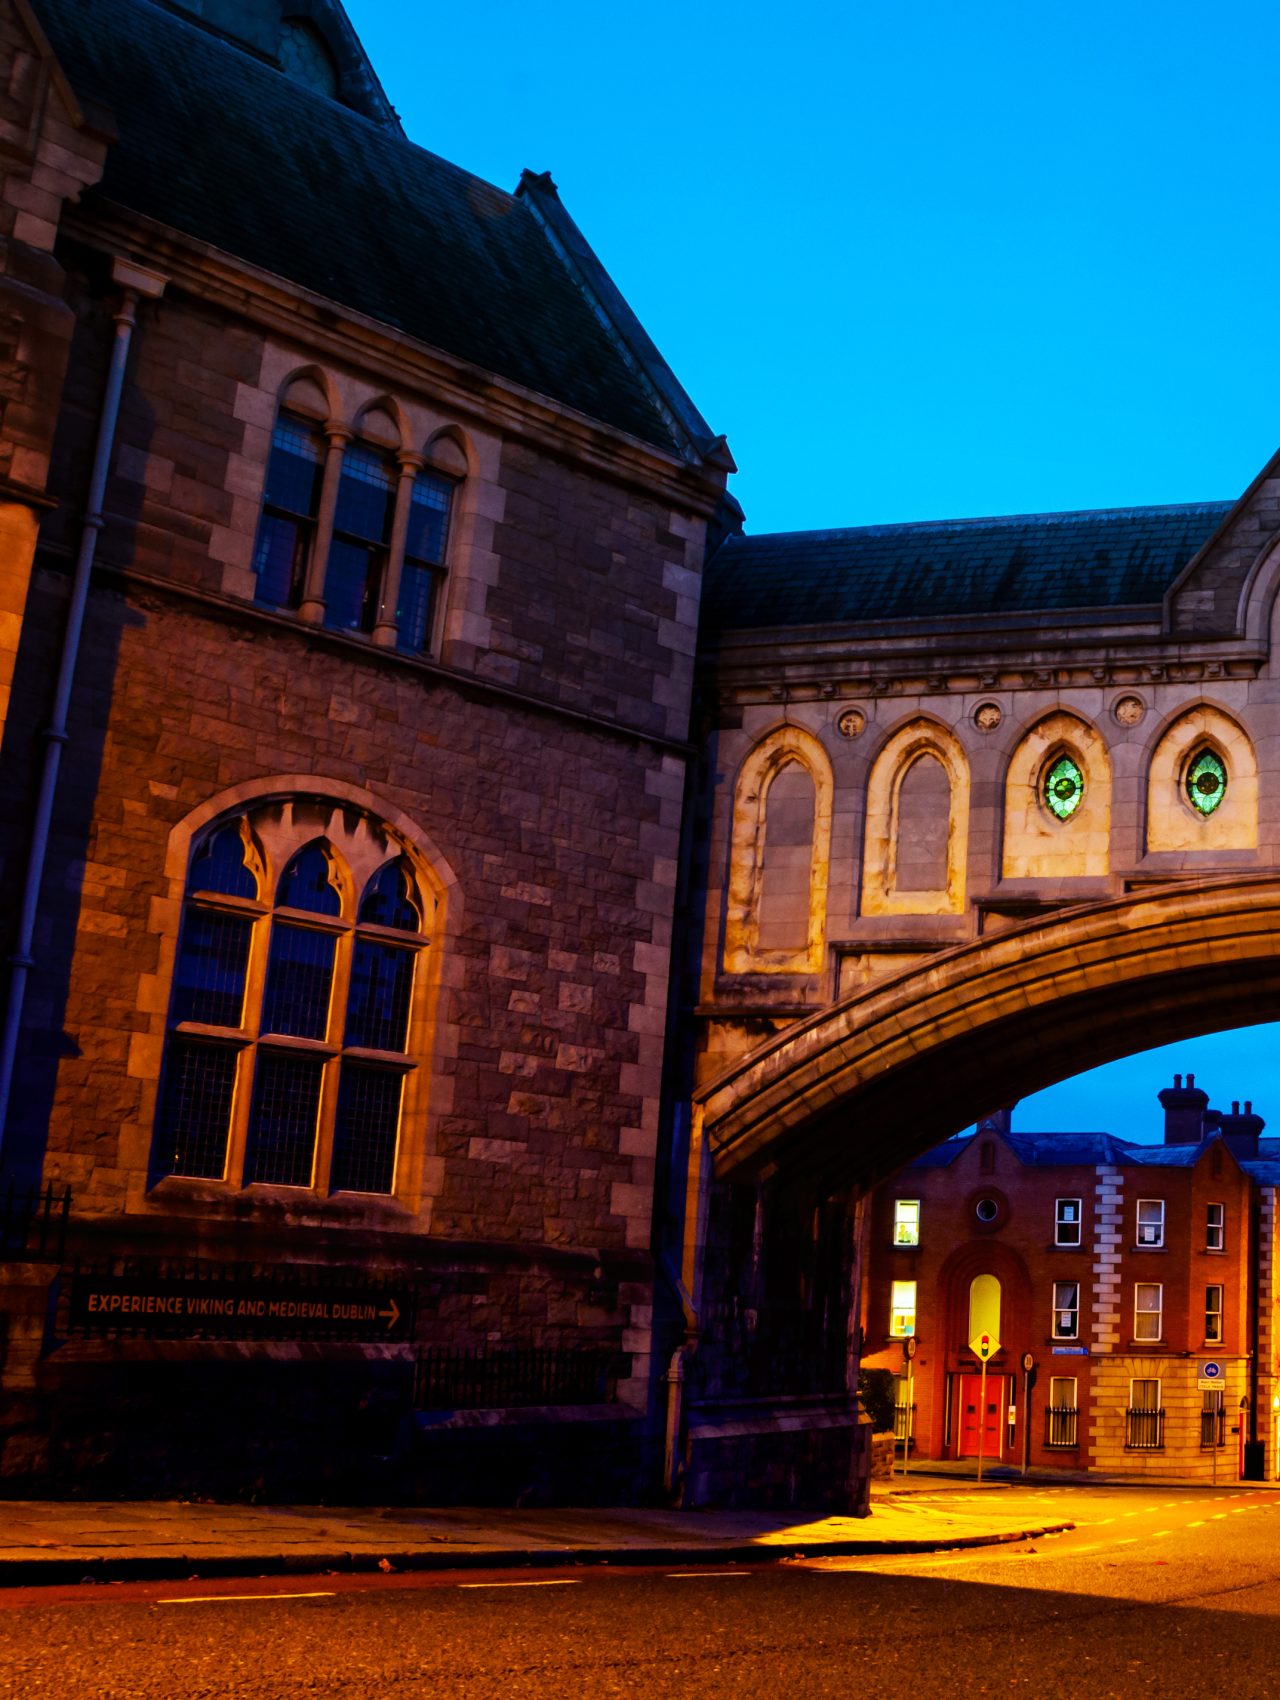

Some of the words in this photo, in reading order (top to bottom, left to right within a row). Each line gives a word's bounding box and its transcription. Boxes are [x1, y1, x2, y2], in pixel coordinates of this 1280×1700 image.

[88, 1294, 182, 1313] EXPERIENCE
[187, 1298, 234, 1315] VIKING
[237, 1300, 265, 1316] AND
[268, 1301, 329, 1318] MEDIEVAL
[332, 1304, 376, 1320] DUBLIN
